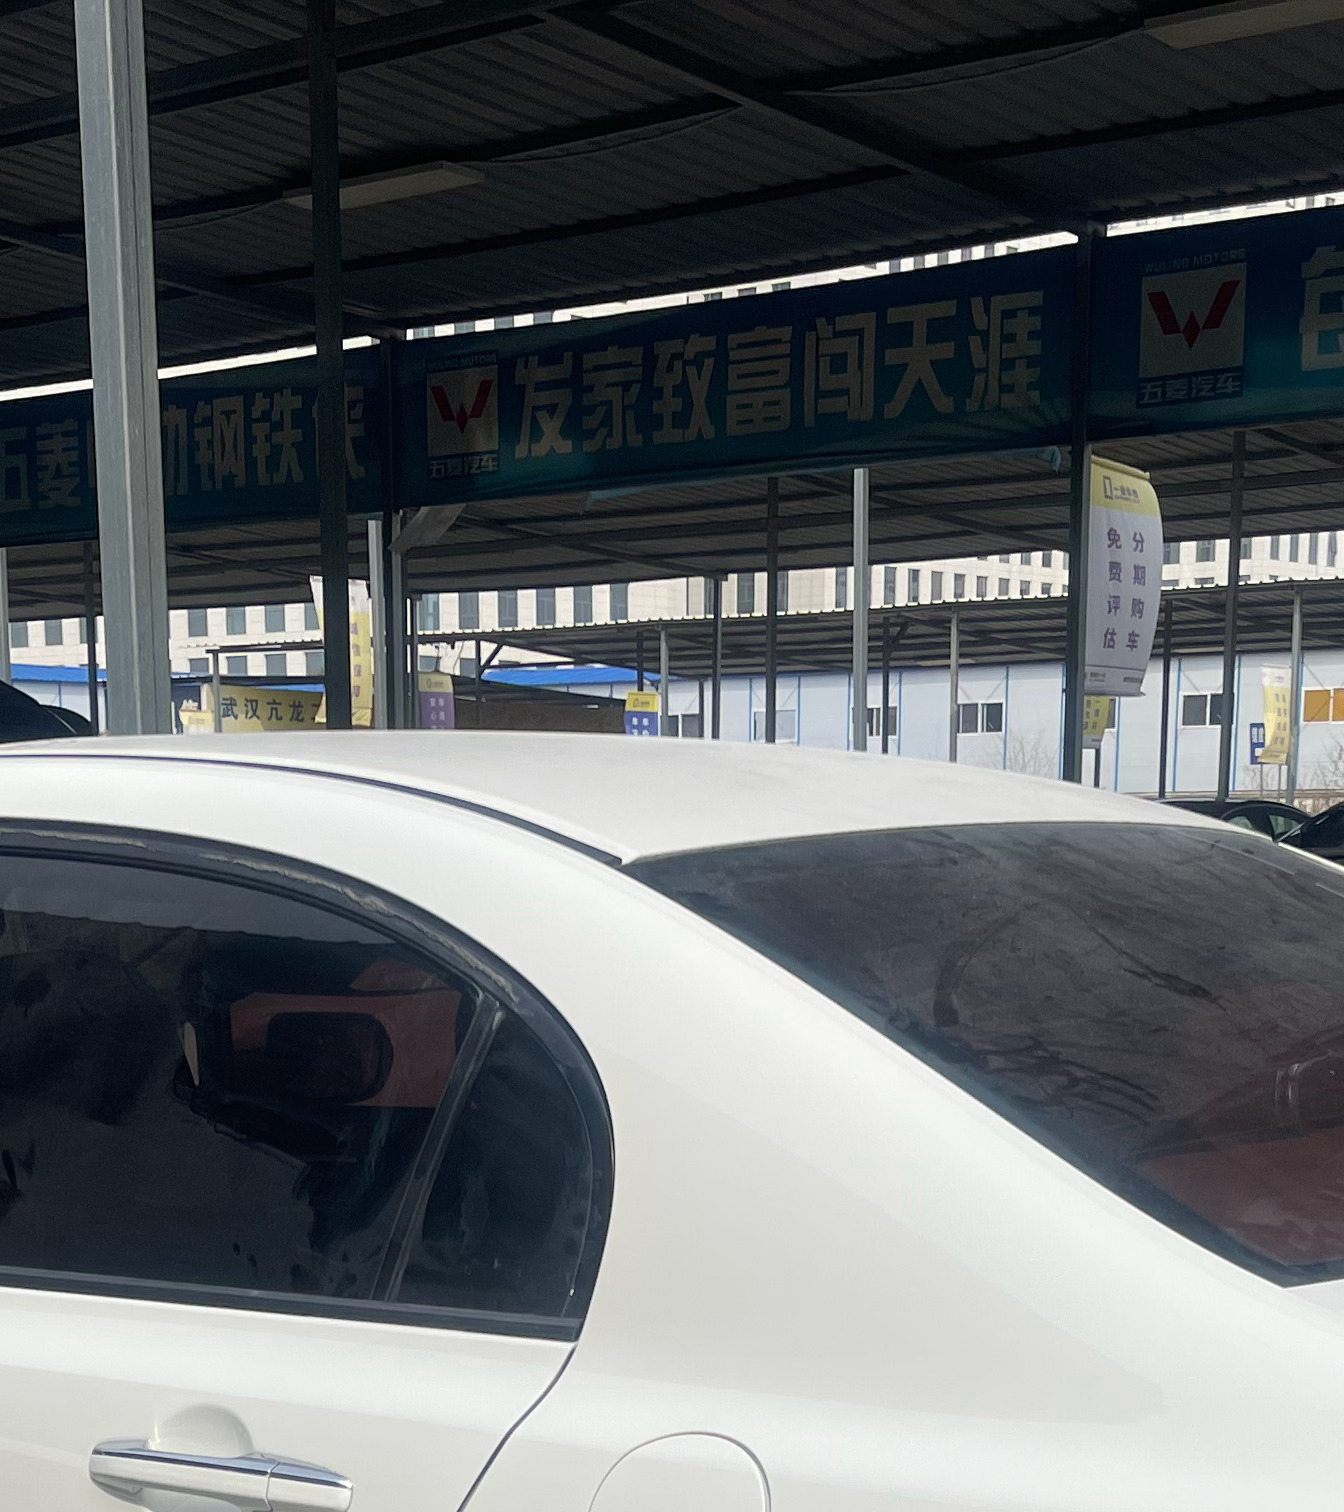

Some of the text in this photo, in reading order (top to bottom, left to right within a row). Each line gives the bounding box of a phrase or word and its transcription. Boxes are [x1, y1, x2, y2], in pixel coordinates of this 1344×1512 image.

[514, 289, 1045, 460] 发家致富闯天涯
[1125, 531, 1147, 652] 分期购车
